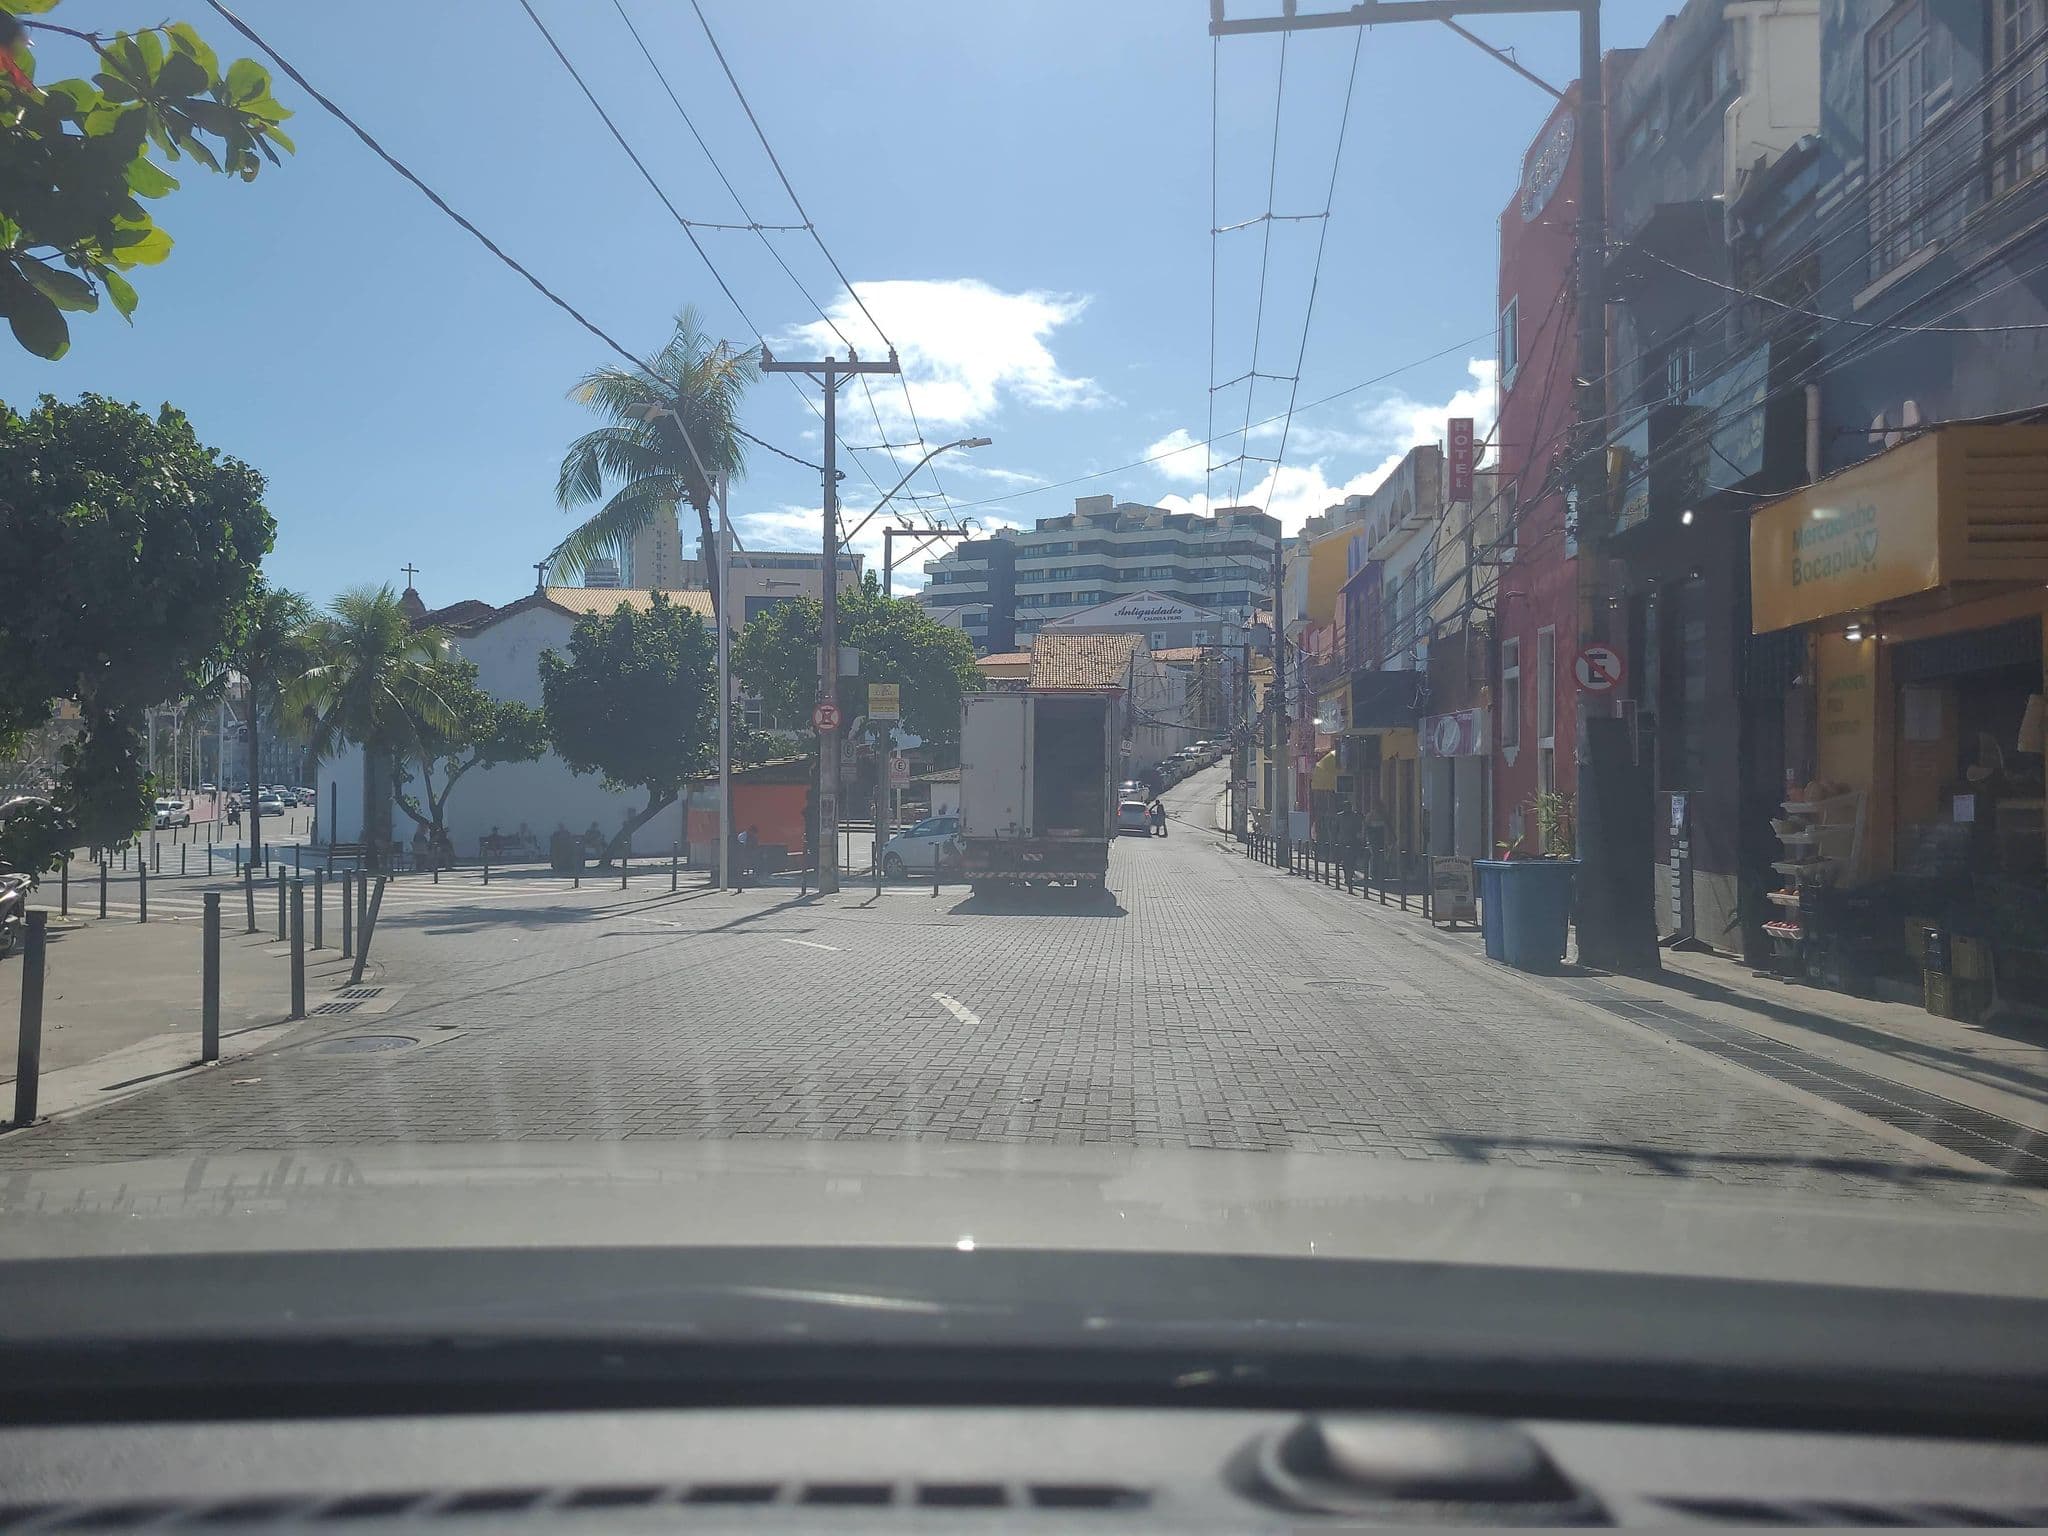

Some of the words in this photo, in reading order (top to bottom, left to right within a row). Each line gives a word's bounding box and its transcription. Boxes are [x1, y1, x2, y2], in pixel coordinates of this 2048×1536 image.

[1454, 421, 1469, 488] HOTEL
[1114, 606, 1183, 620] Antiguidades
[1588, 653, 1607, 683] E
